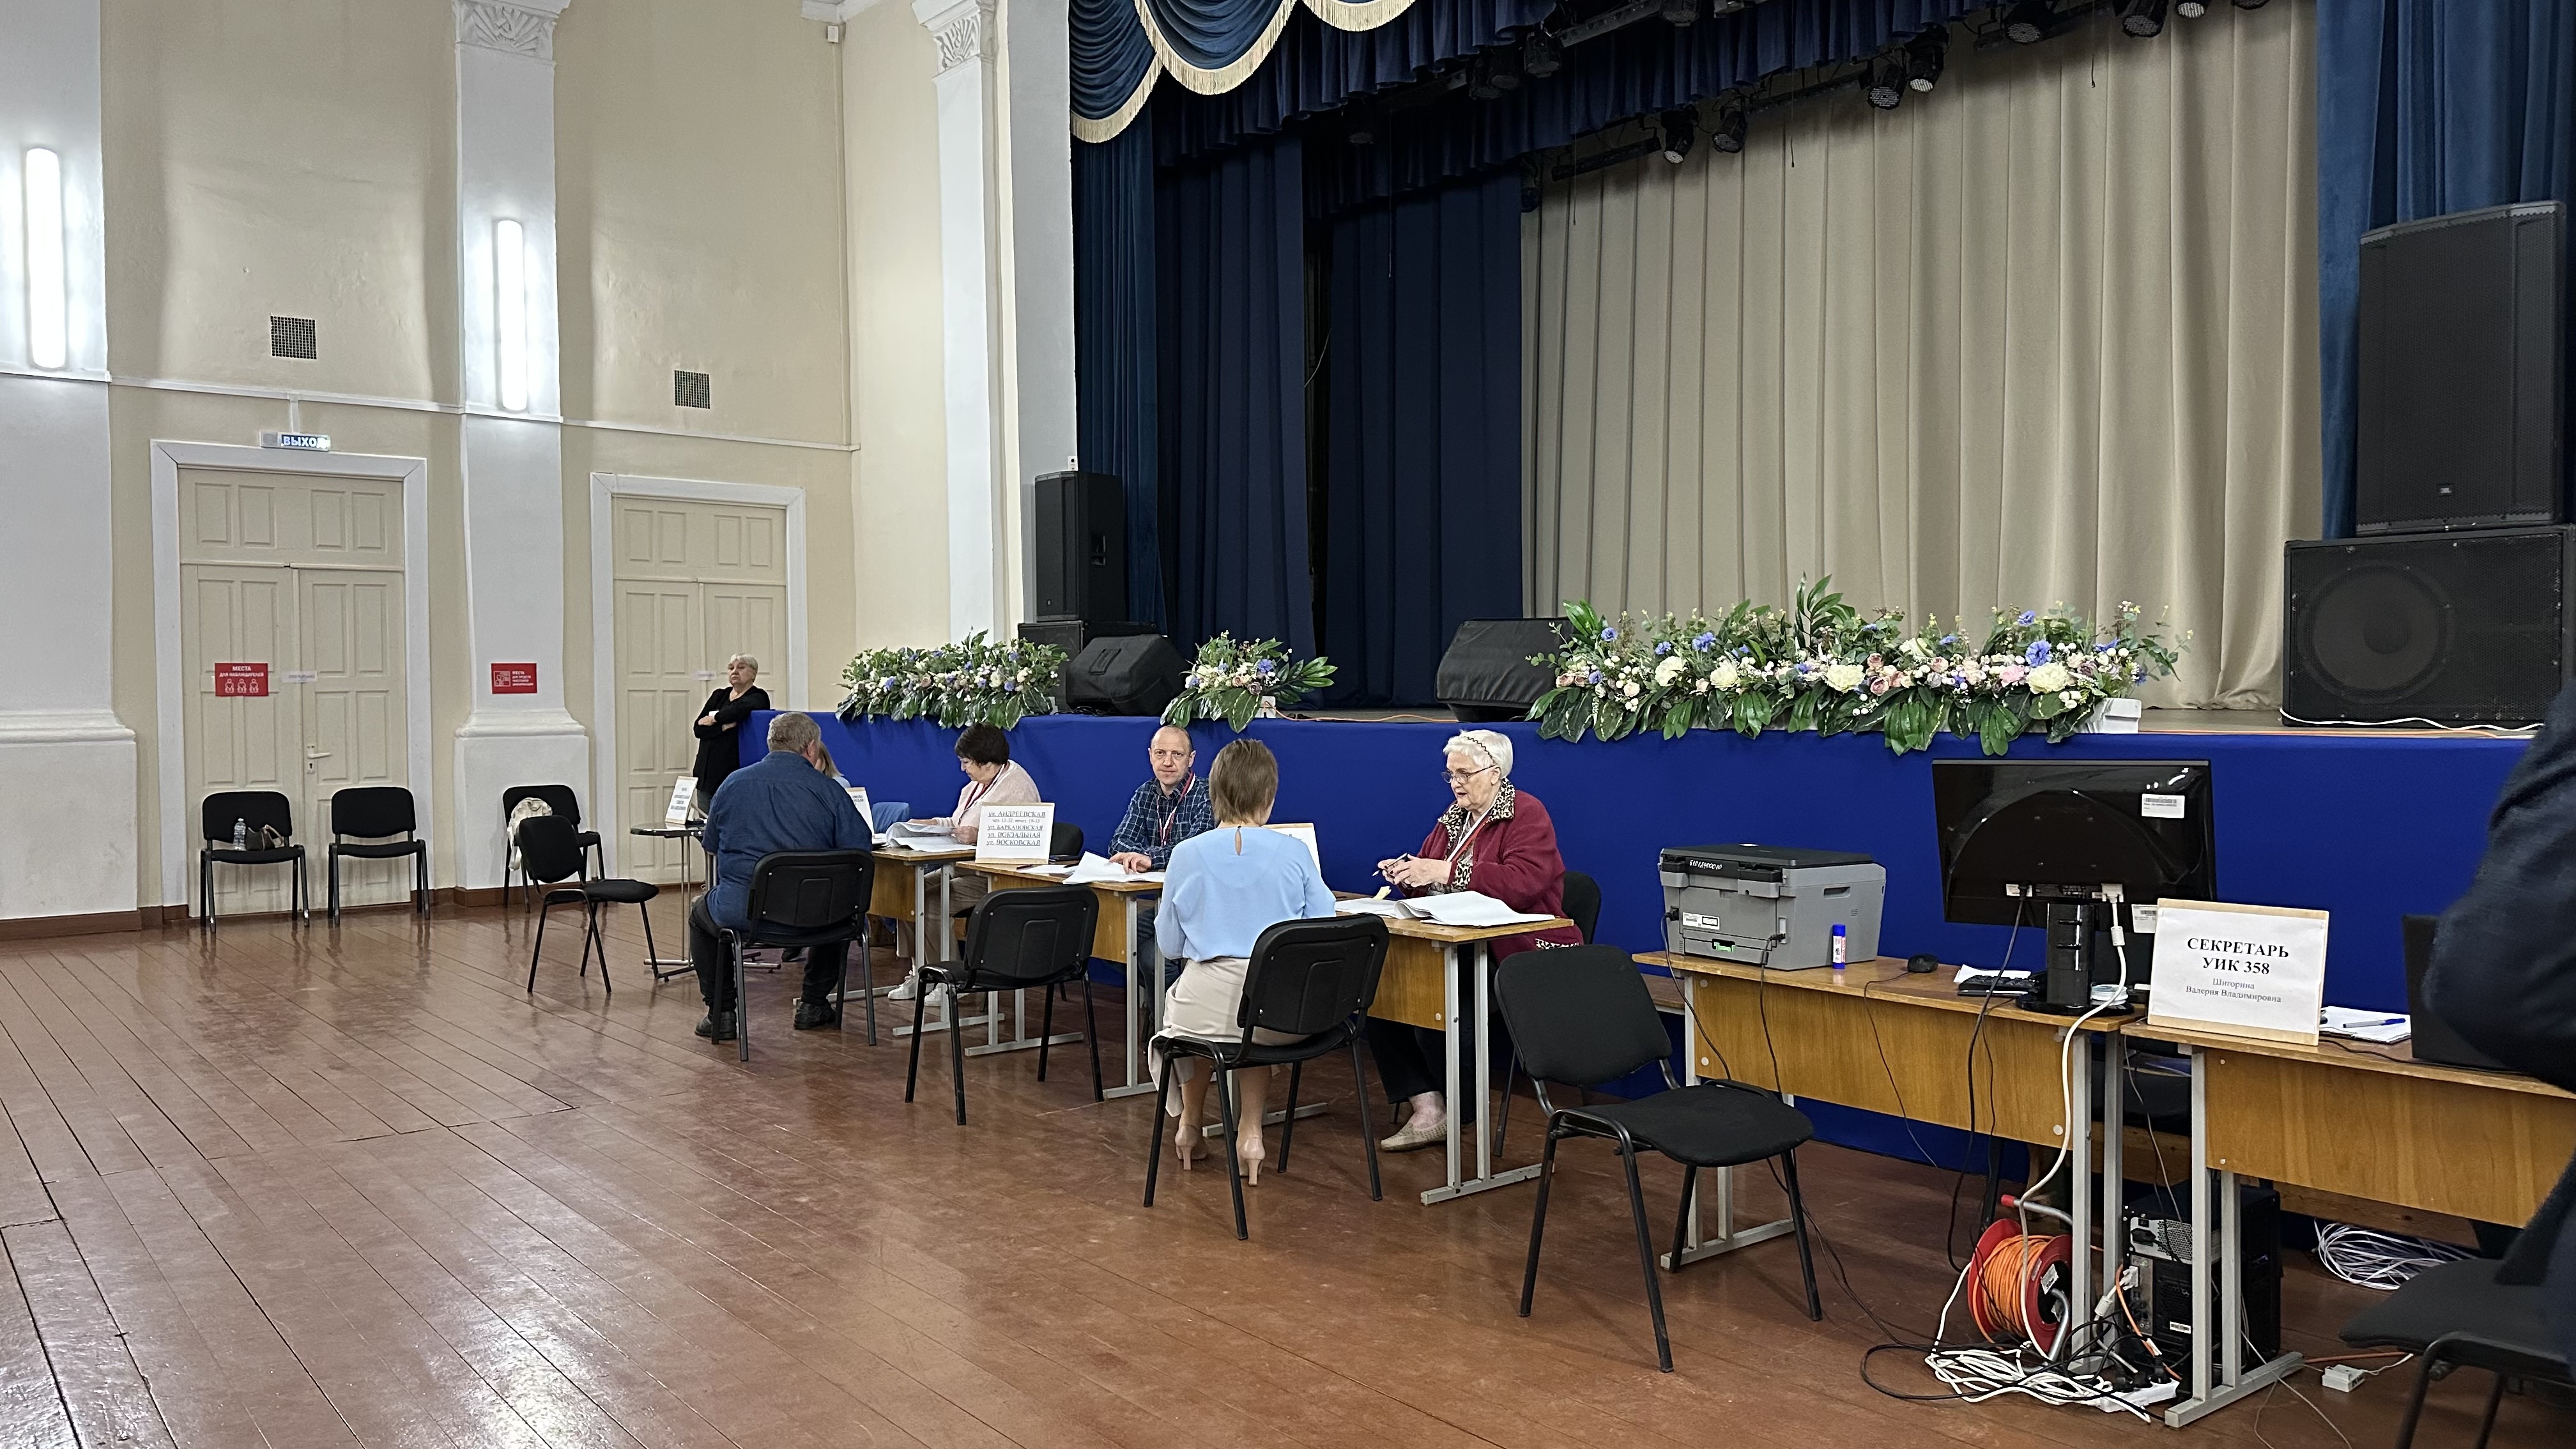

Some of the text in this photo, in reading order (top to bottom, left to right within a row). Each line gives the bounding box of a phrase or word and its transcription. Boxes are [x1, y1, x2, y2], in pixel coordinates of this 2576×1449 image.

[2187, 937, 2289, 958] СЕКРЕТАРЬ
[2202, 957, 2270, 975] УИК 358
[2212, 978, 2255, 990] Шигорина
[2186, 985, 2282, 1002] Валерия Владимировна
